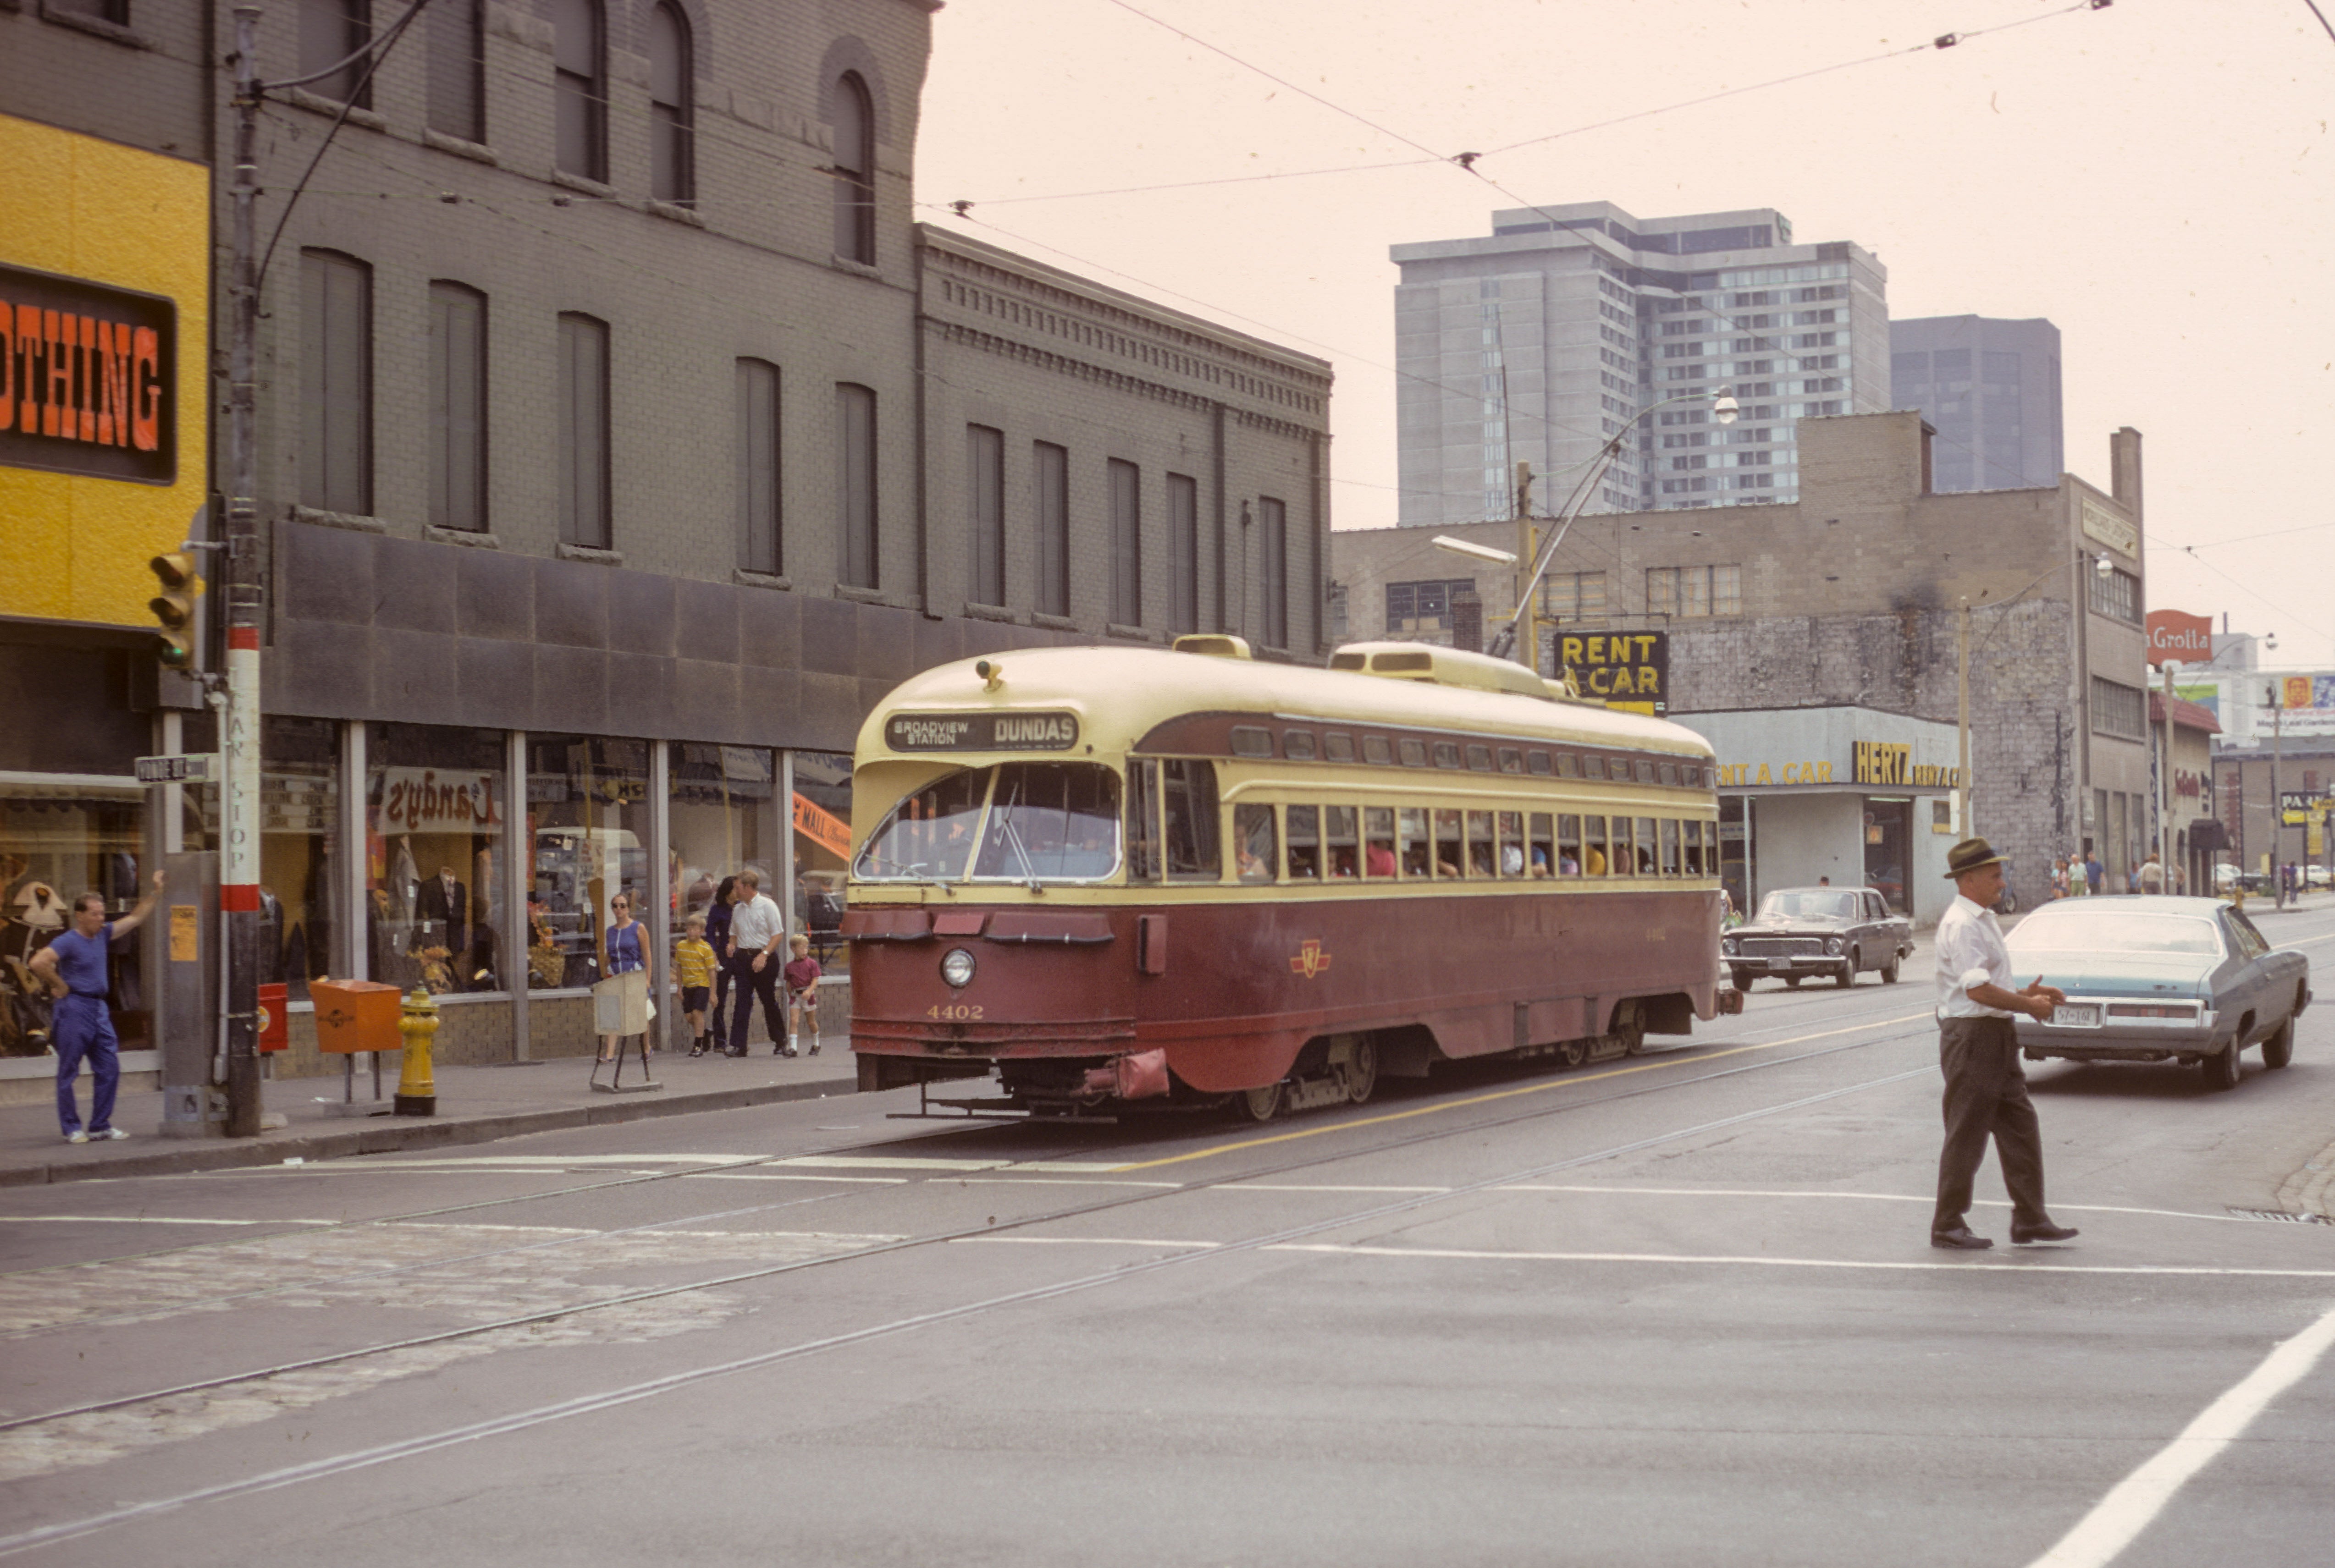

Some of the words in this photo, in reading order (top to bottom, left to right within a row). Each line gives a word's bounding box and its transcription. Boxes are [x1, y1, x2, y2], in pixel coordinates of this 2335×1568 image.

[1562, 636, 1657, 664] RENT
[2154, 626, 2208, 649] Grotta
[1590, 666, 1659, 694] CAR
[231, 693, 244, 757] CAR
[894, 721, 968, 733] BROADVIEW
[994, 718, 1074, 742] DUNDAS
[907, 733, 955, 745] STATION
[1755, 763, 1773, 785] A
[1782, 761, 1833, 785] CAR
[1857, 741, 1912, 785] HERTZ
[1914, 765, 1941, 787] RENT
[230, 781, 245, 869] STOP
[802, 806, 824, 839] MALL
[927, 1005, 984, 1020] 4402
